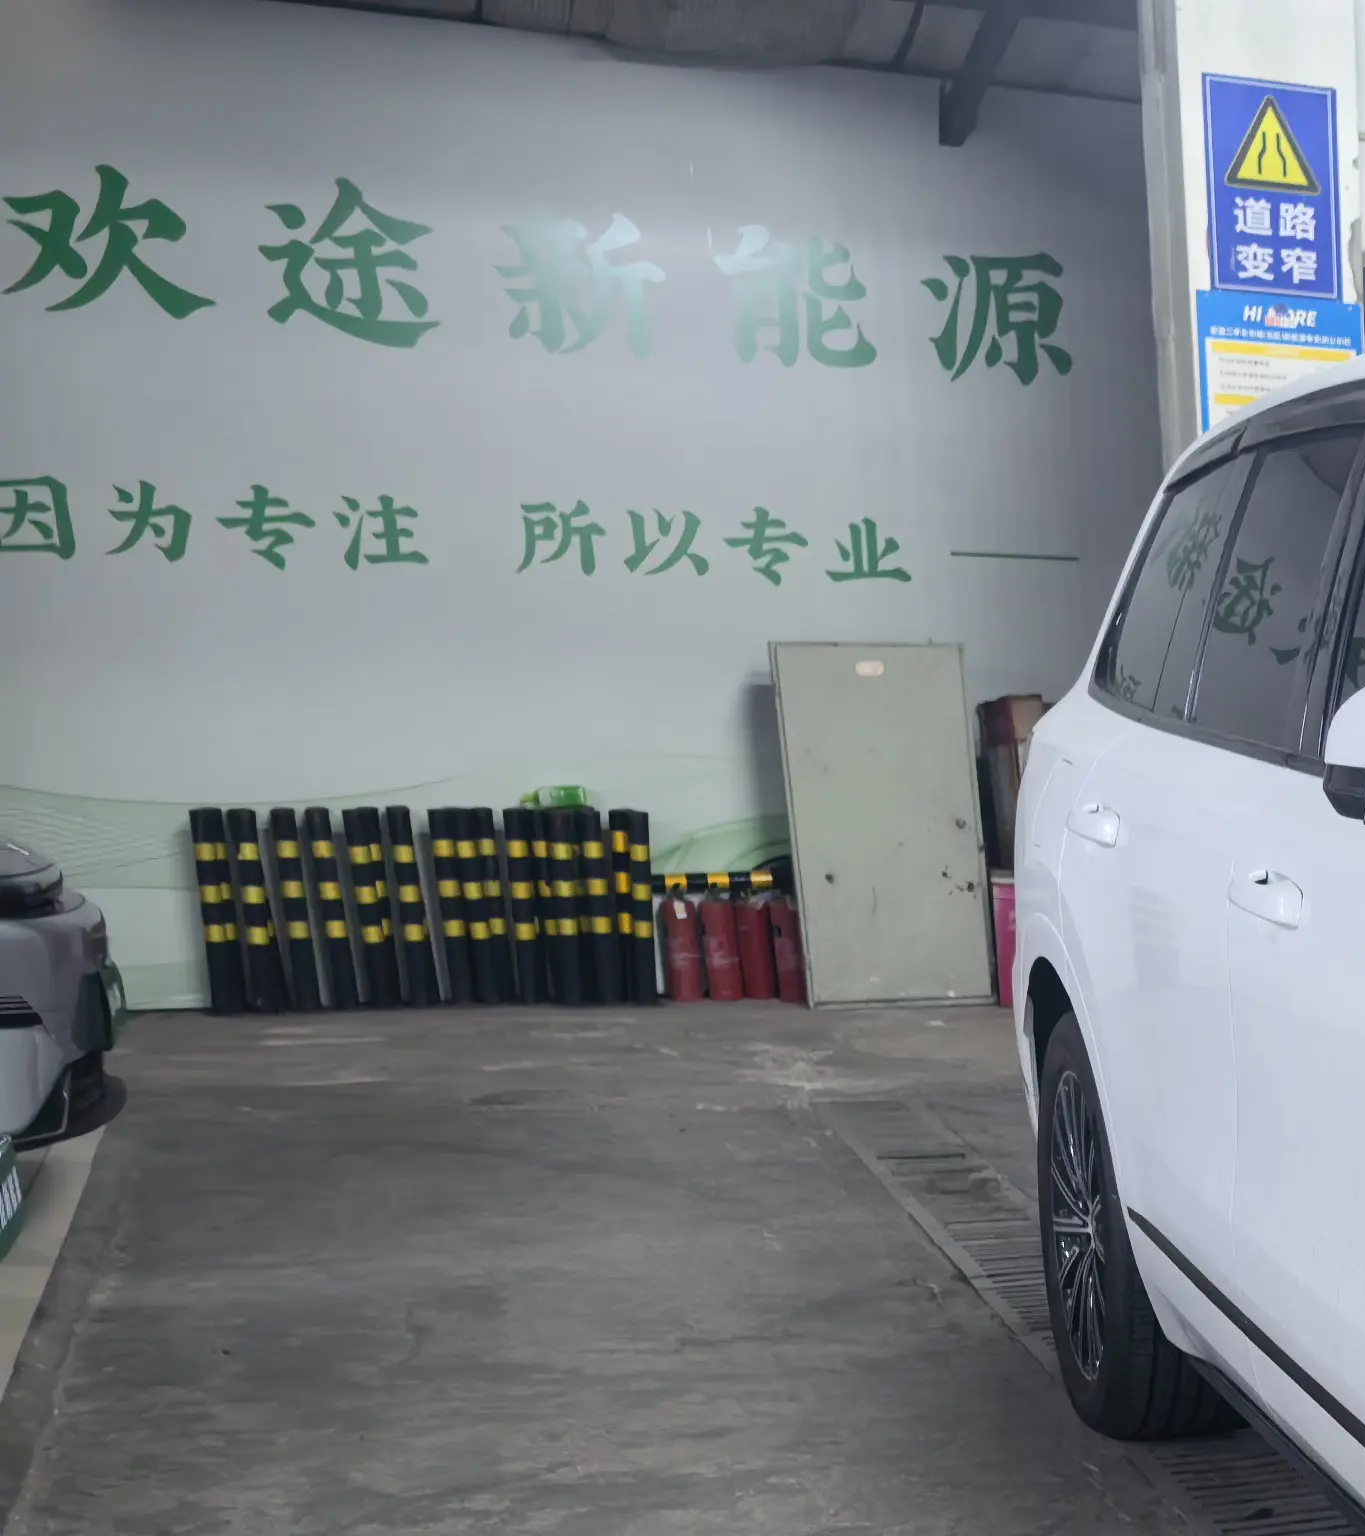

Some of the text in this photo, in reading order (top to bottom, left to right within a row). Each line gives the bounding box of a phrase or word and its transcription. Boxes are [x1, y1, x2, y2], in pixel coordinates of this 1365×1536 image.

[1234, 196, 1316, 241] 道路
[2, 164, 1074, 385] 欢途新能源
[1236, 243, 1318, 284] 变窄
[0, 475, 912, 587] 因为专注 所以专业
